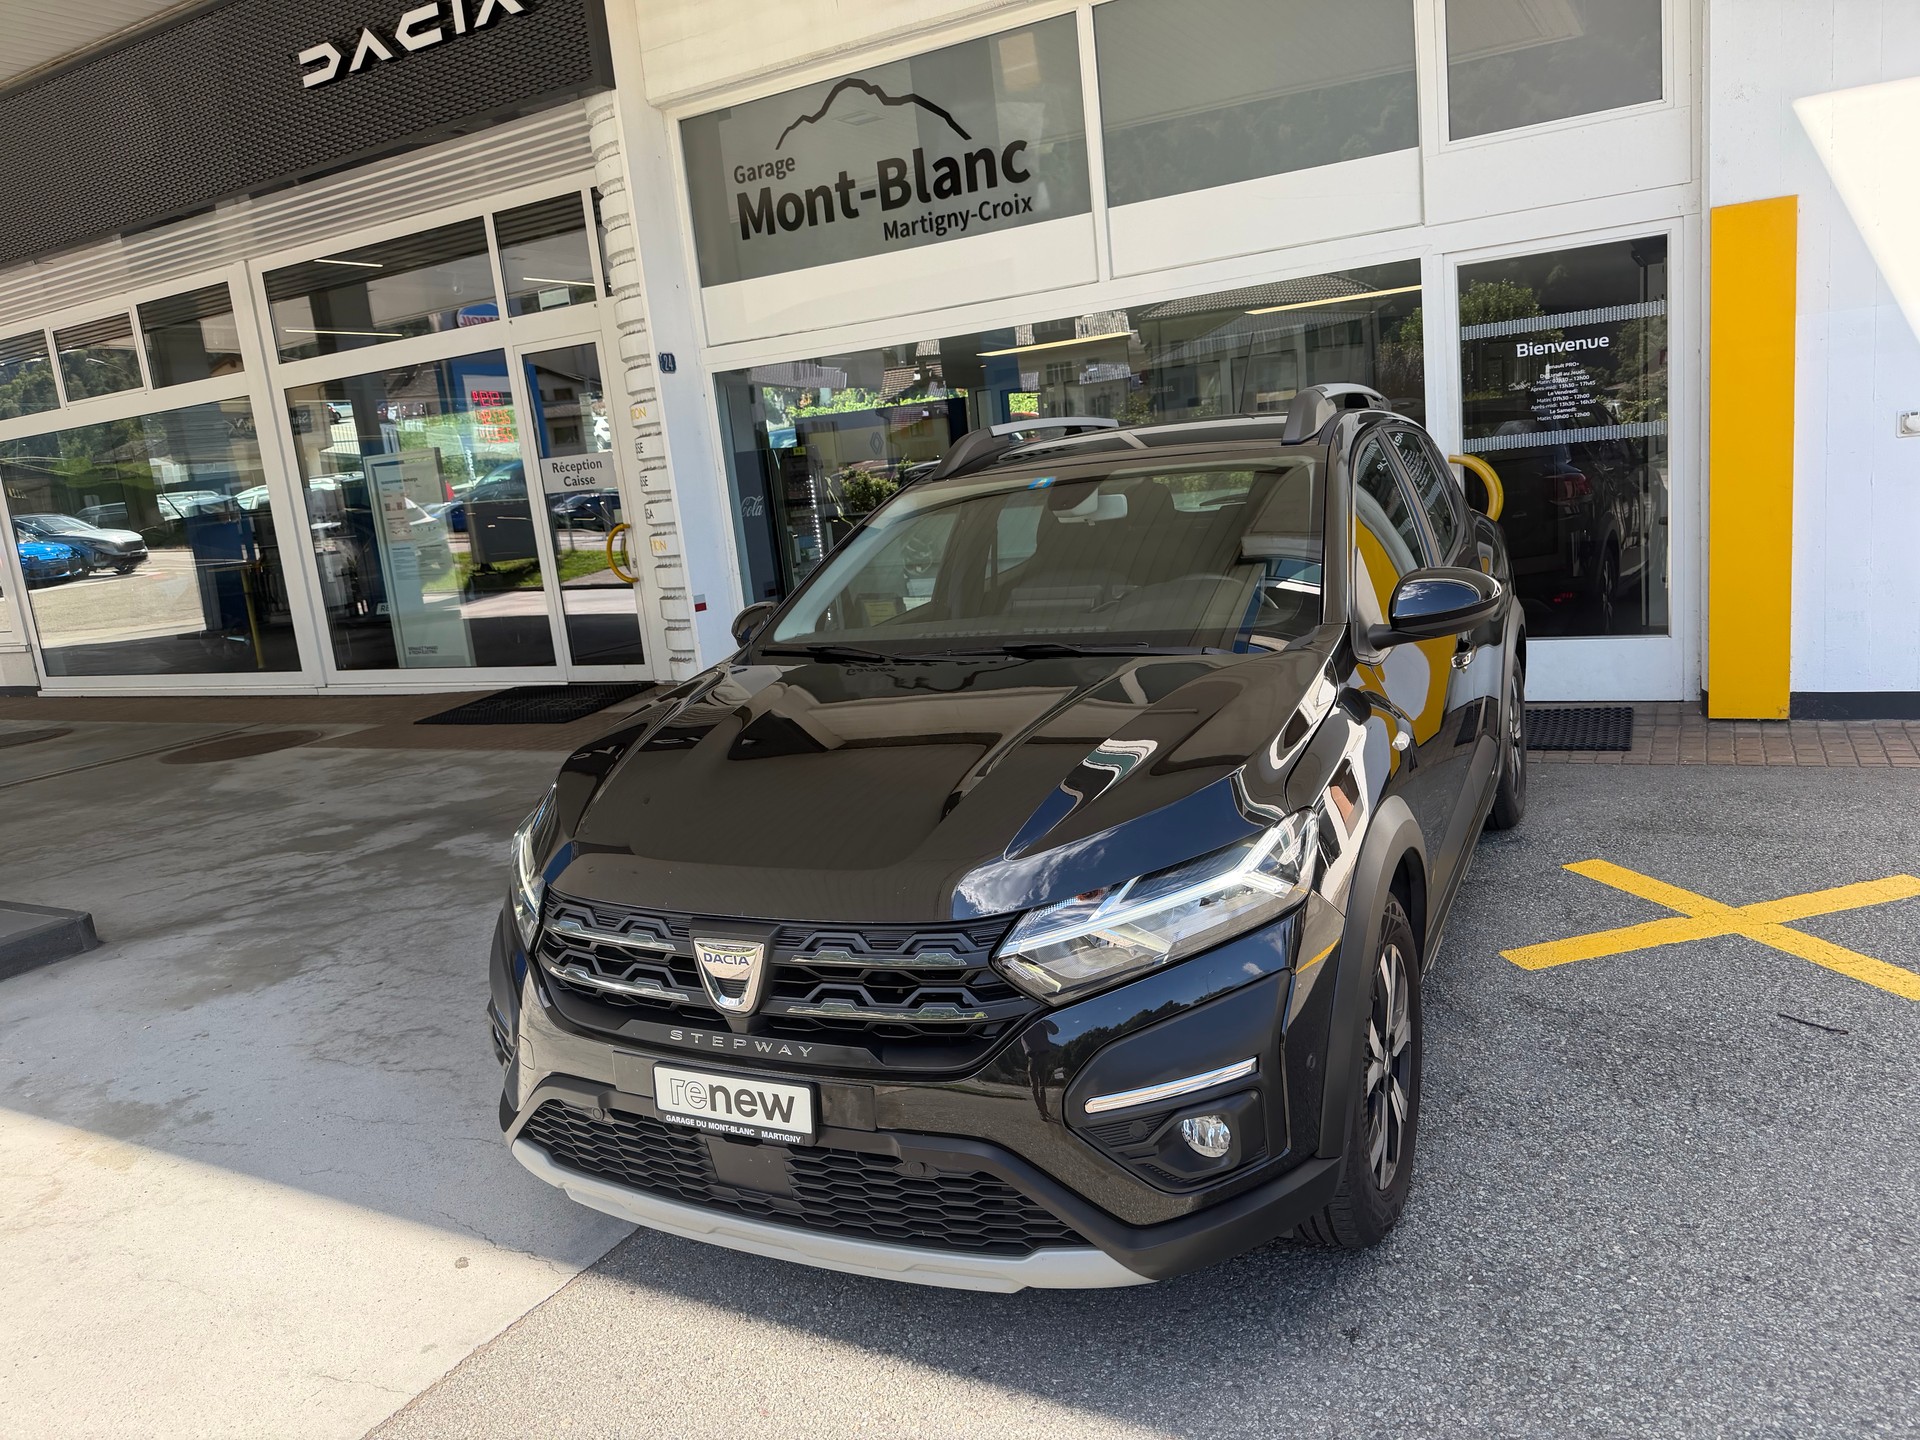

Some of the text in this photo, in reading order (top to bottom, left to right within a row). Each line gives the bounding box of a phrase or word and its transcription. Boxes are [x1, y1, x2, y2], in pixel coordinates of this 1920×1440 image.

[733, 157, 796, 184] Garage
[736, 139, 1031, 241] Mont-Blanc
[883, 193, 1034, 241] Martigny-Croix
[1516, 336, 1610, 358] Bienvenue
[552, 458, 603, 475] Réception
[563, 475, 596, 488] Caisse
[703, 952, 750, 966] DACIA
[670, 1030, 813, 1057] STEPWAY
[670, 1077, 795, 1124] renew
[665, 1114, 801, 1144] GARAGE DU MONT-BLANC MARTIGNY
